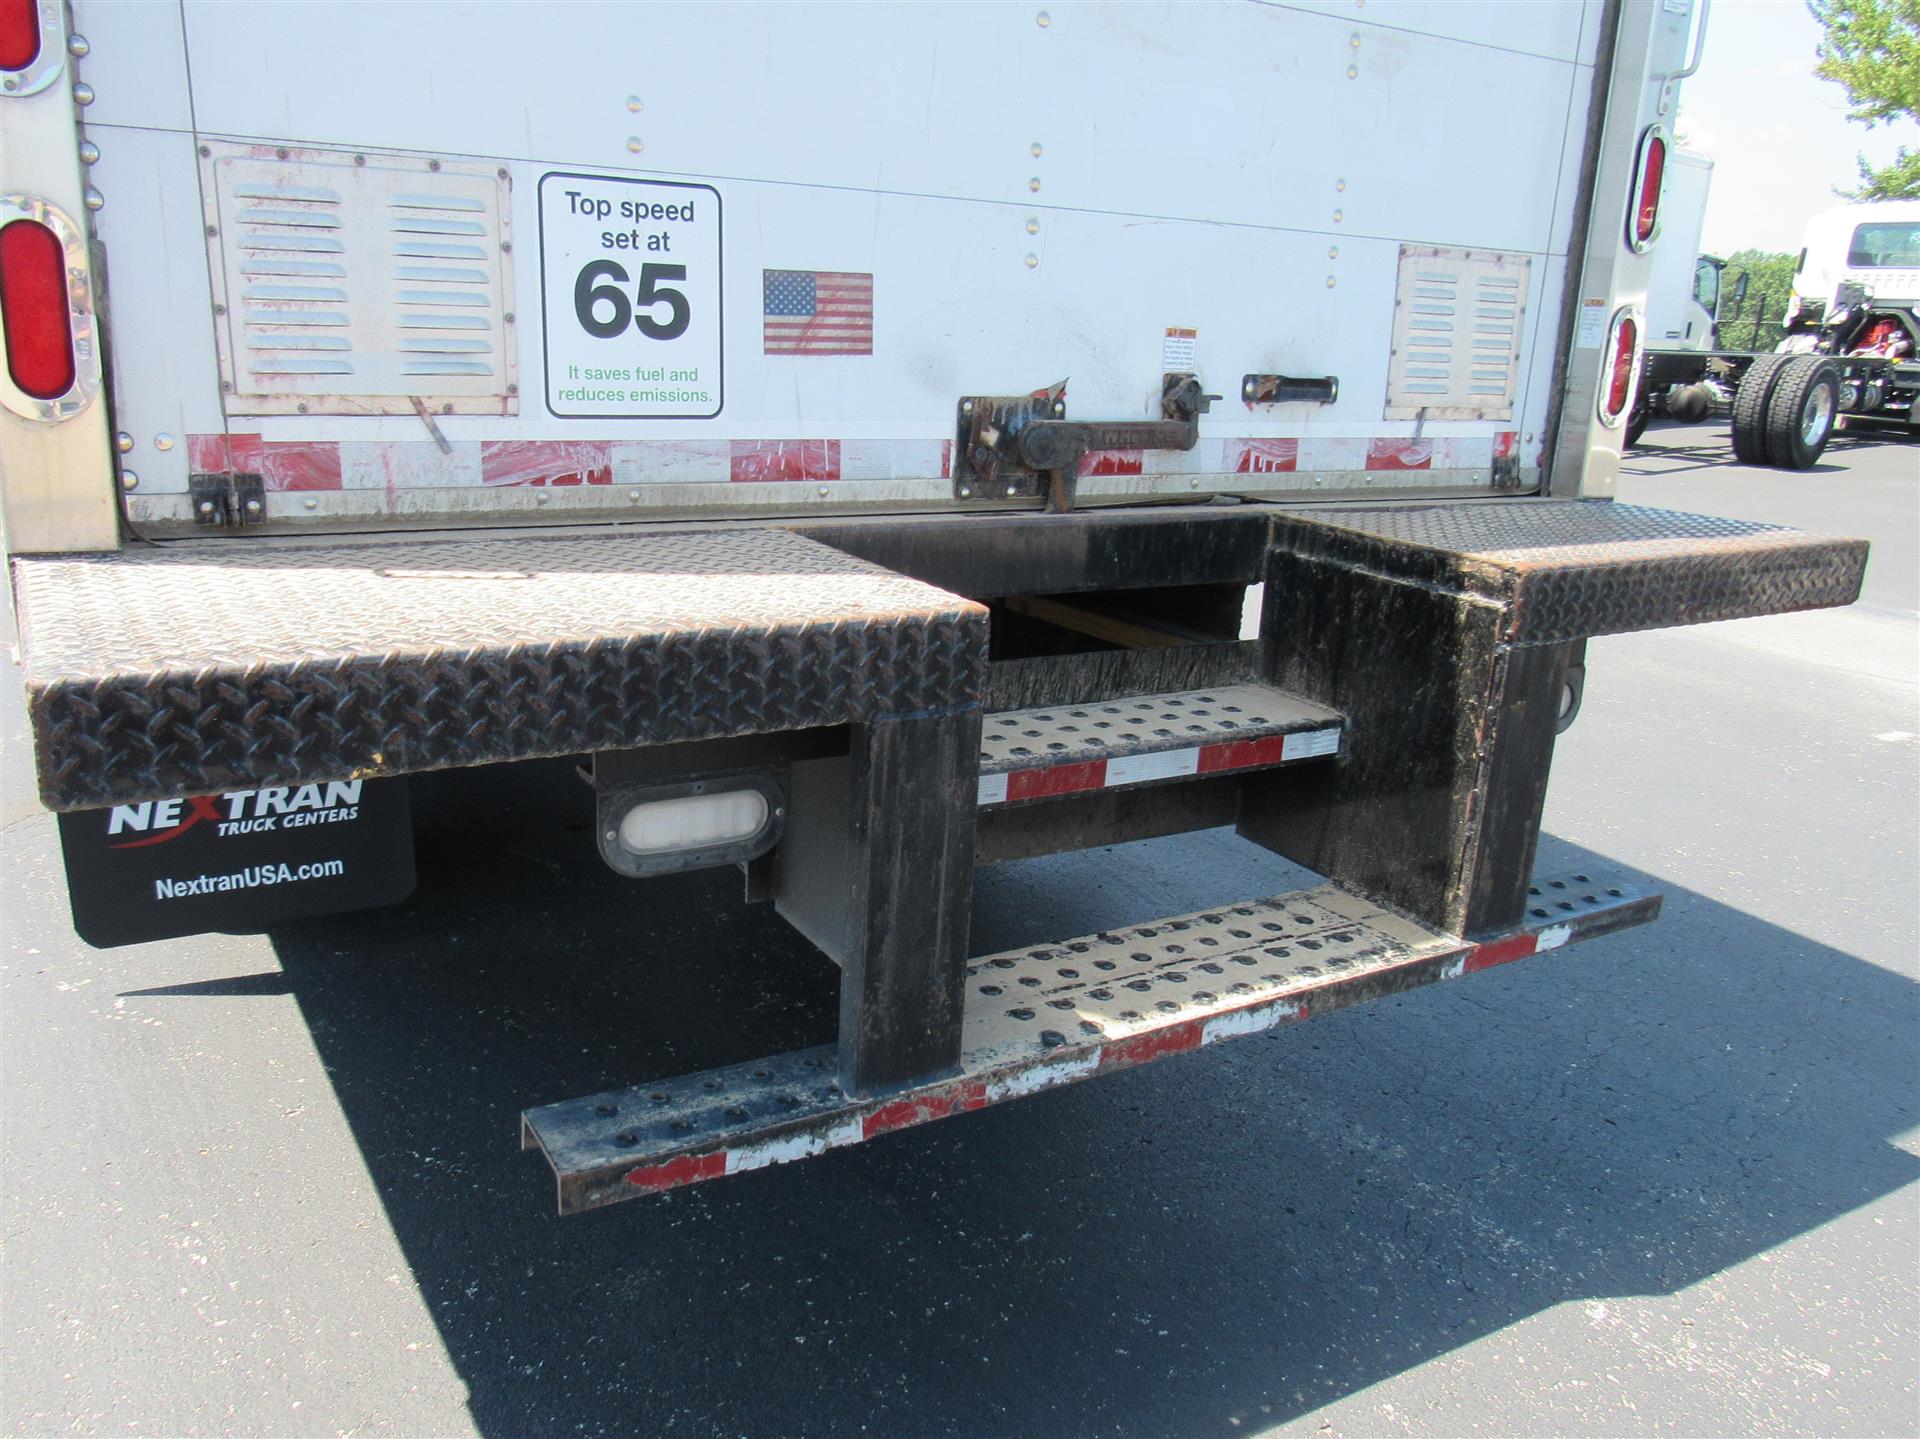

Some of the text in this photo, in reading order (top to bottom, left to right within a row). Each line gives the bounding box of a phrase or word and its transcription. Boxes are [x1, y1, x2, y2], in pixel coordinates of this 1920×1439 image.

[565, 191, 695, 224] Top speed
[601, 229, 671, 252] set at
[574, 259, 691, 341] 65
[568, 365, 699, 382] It saves fuel and
[558, 386, 713, 402] reduces emissions.
[217, 807, 359, 837] TRUCK CENTERS
[155, 859, 345, 901] NextranUSA.com
